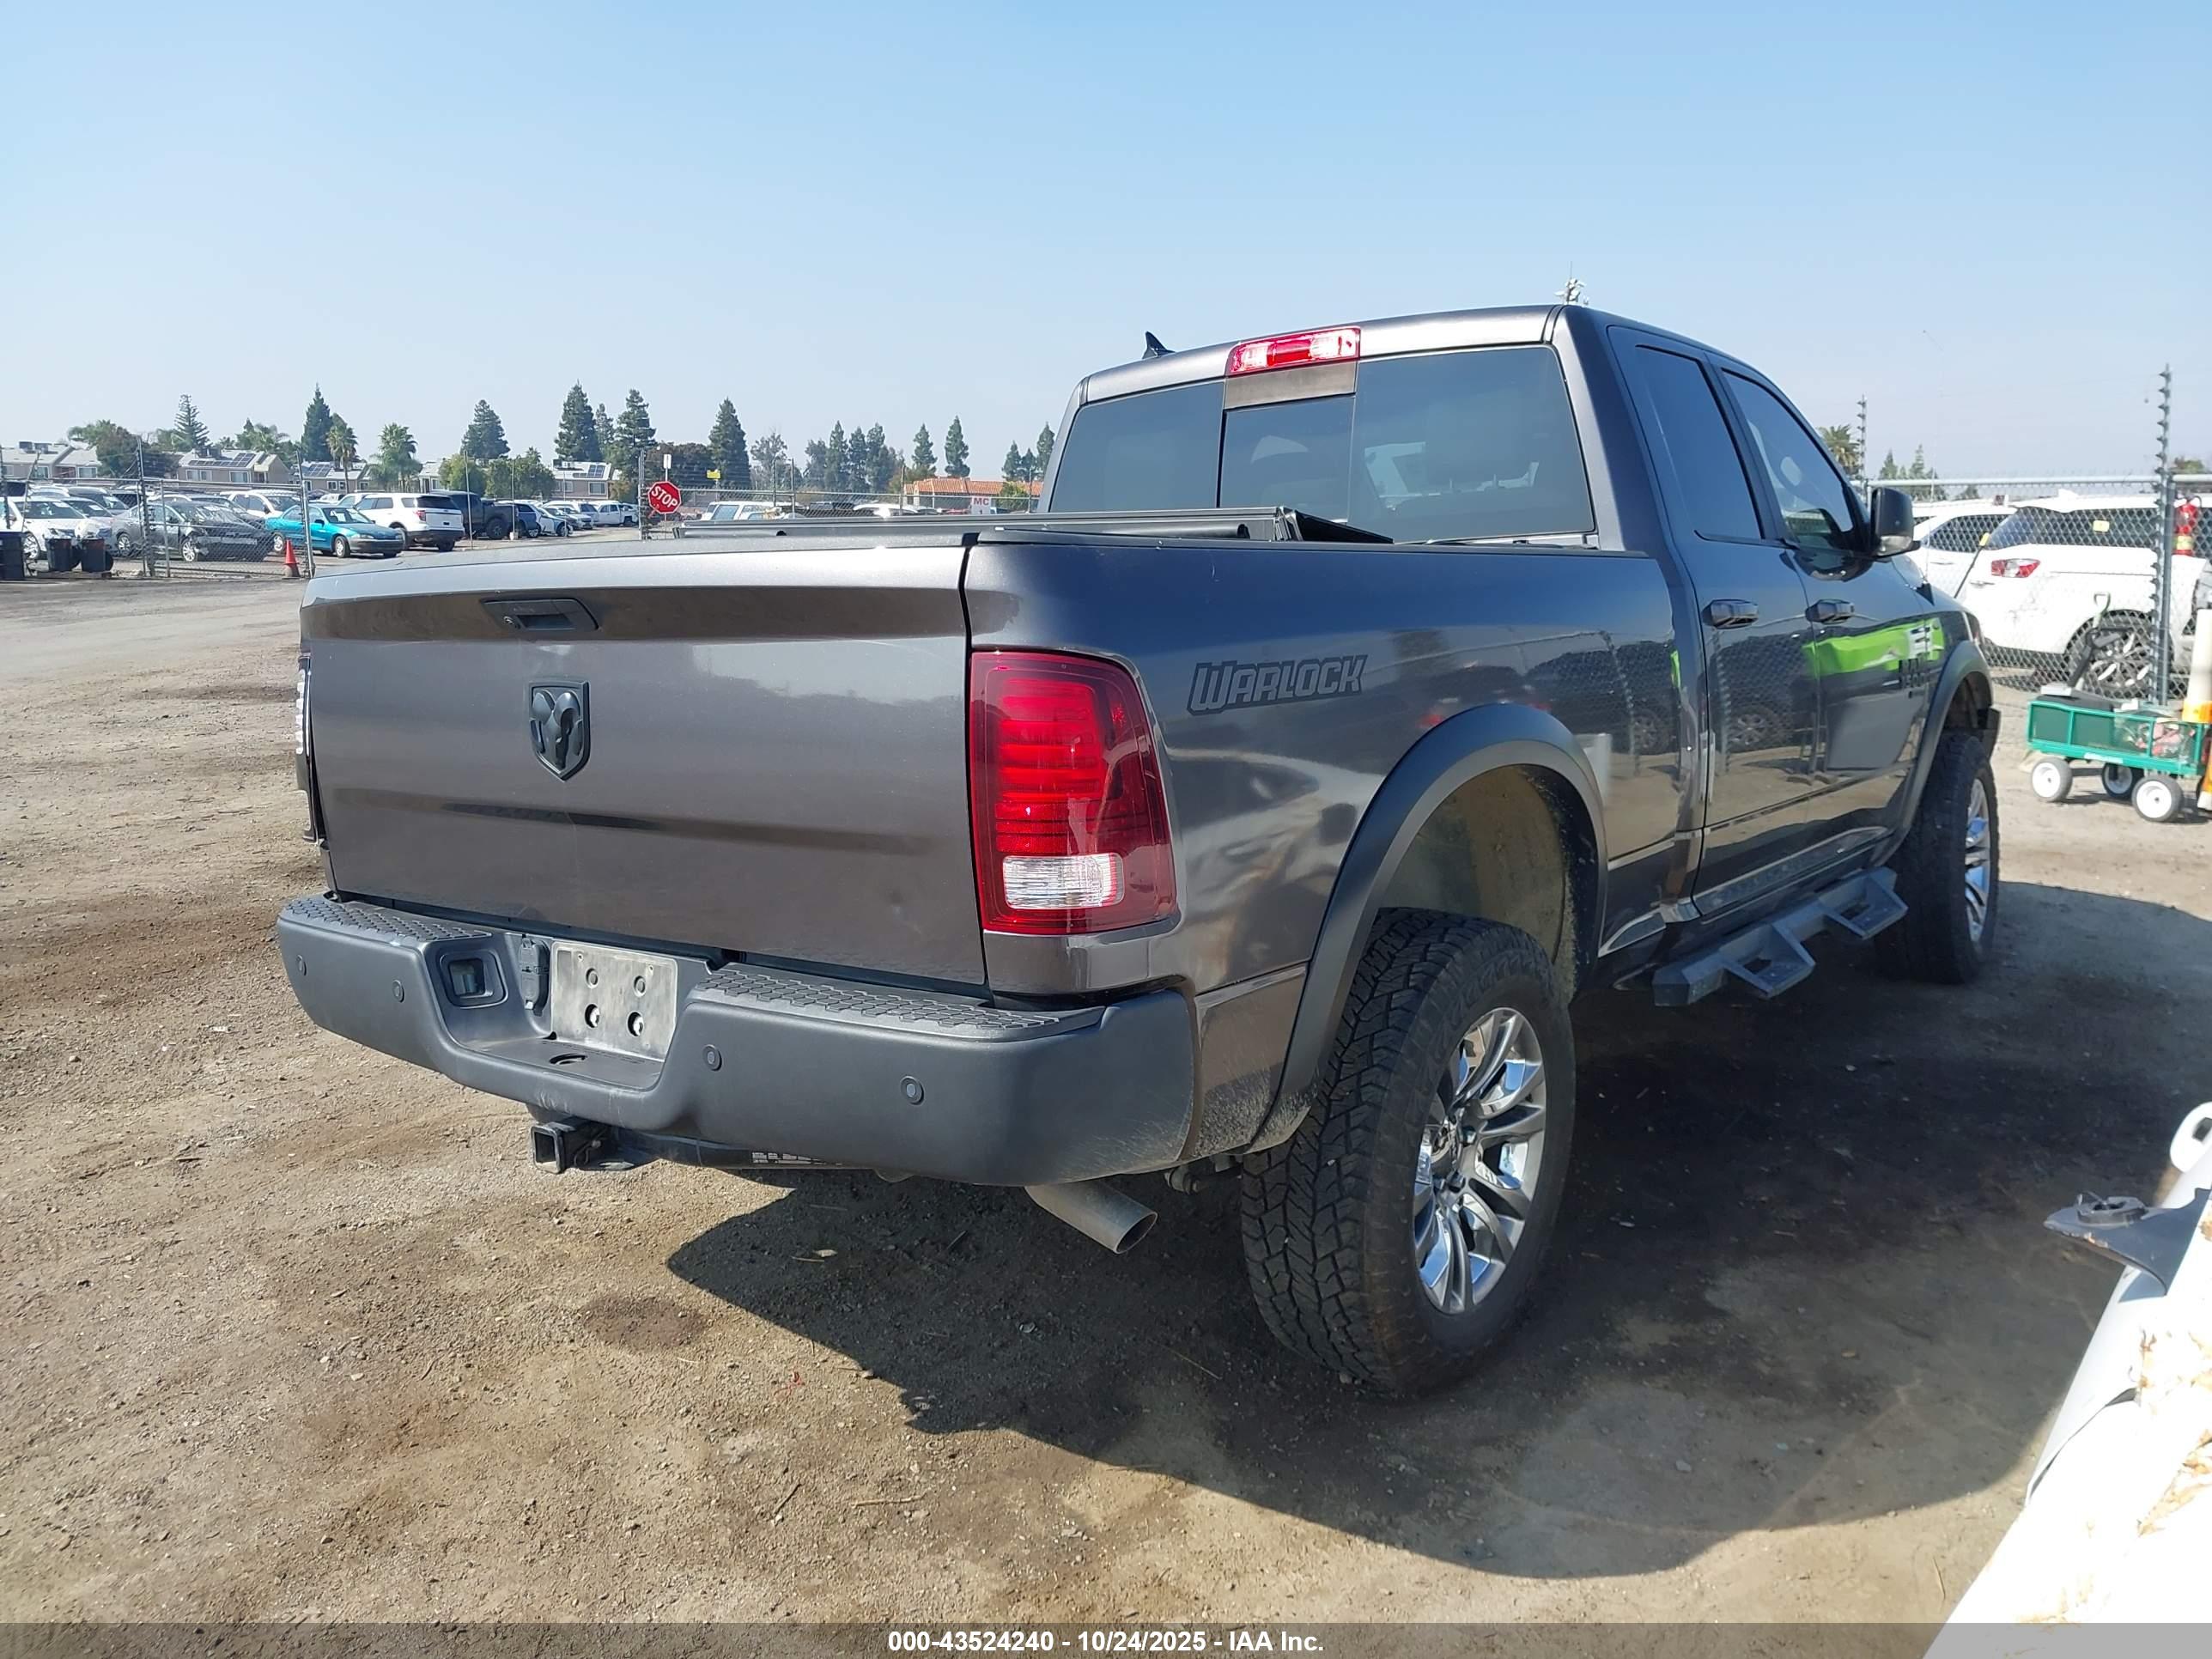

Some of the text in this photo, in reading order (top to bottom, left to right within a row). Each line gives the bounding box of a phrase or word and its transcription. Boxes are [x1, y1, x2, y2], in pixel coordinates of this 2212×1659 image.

[651, 485, 678, 508] STOP
[973, 497, 990, 506] MC
[1187, 654, 1368, 716] WARLOCK
